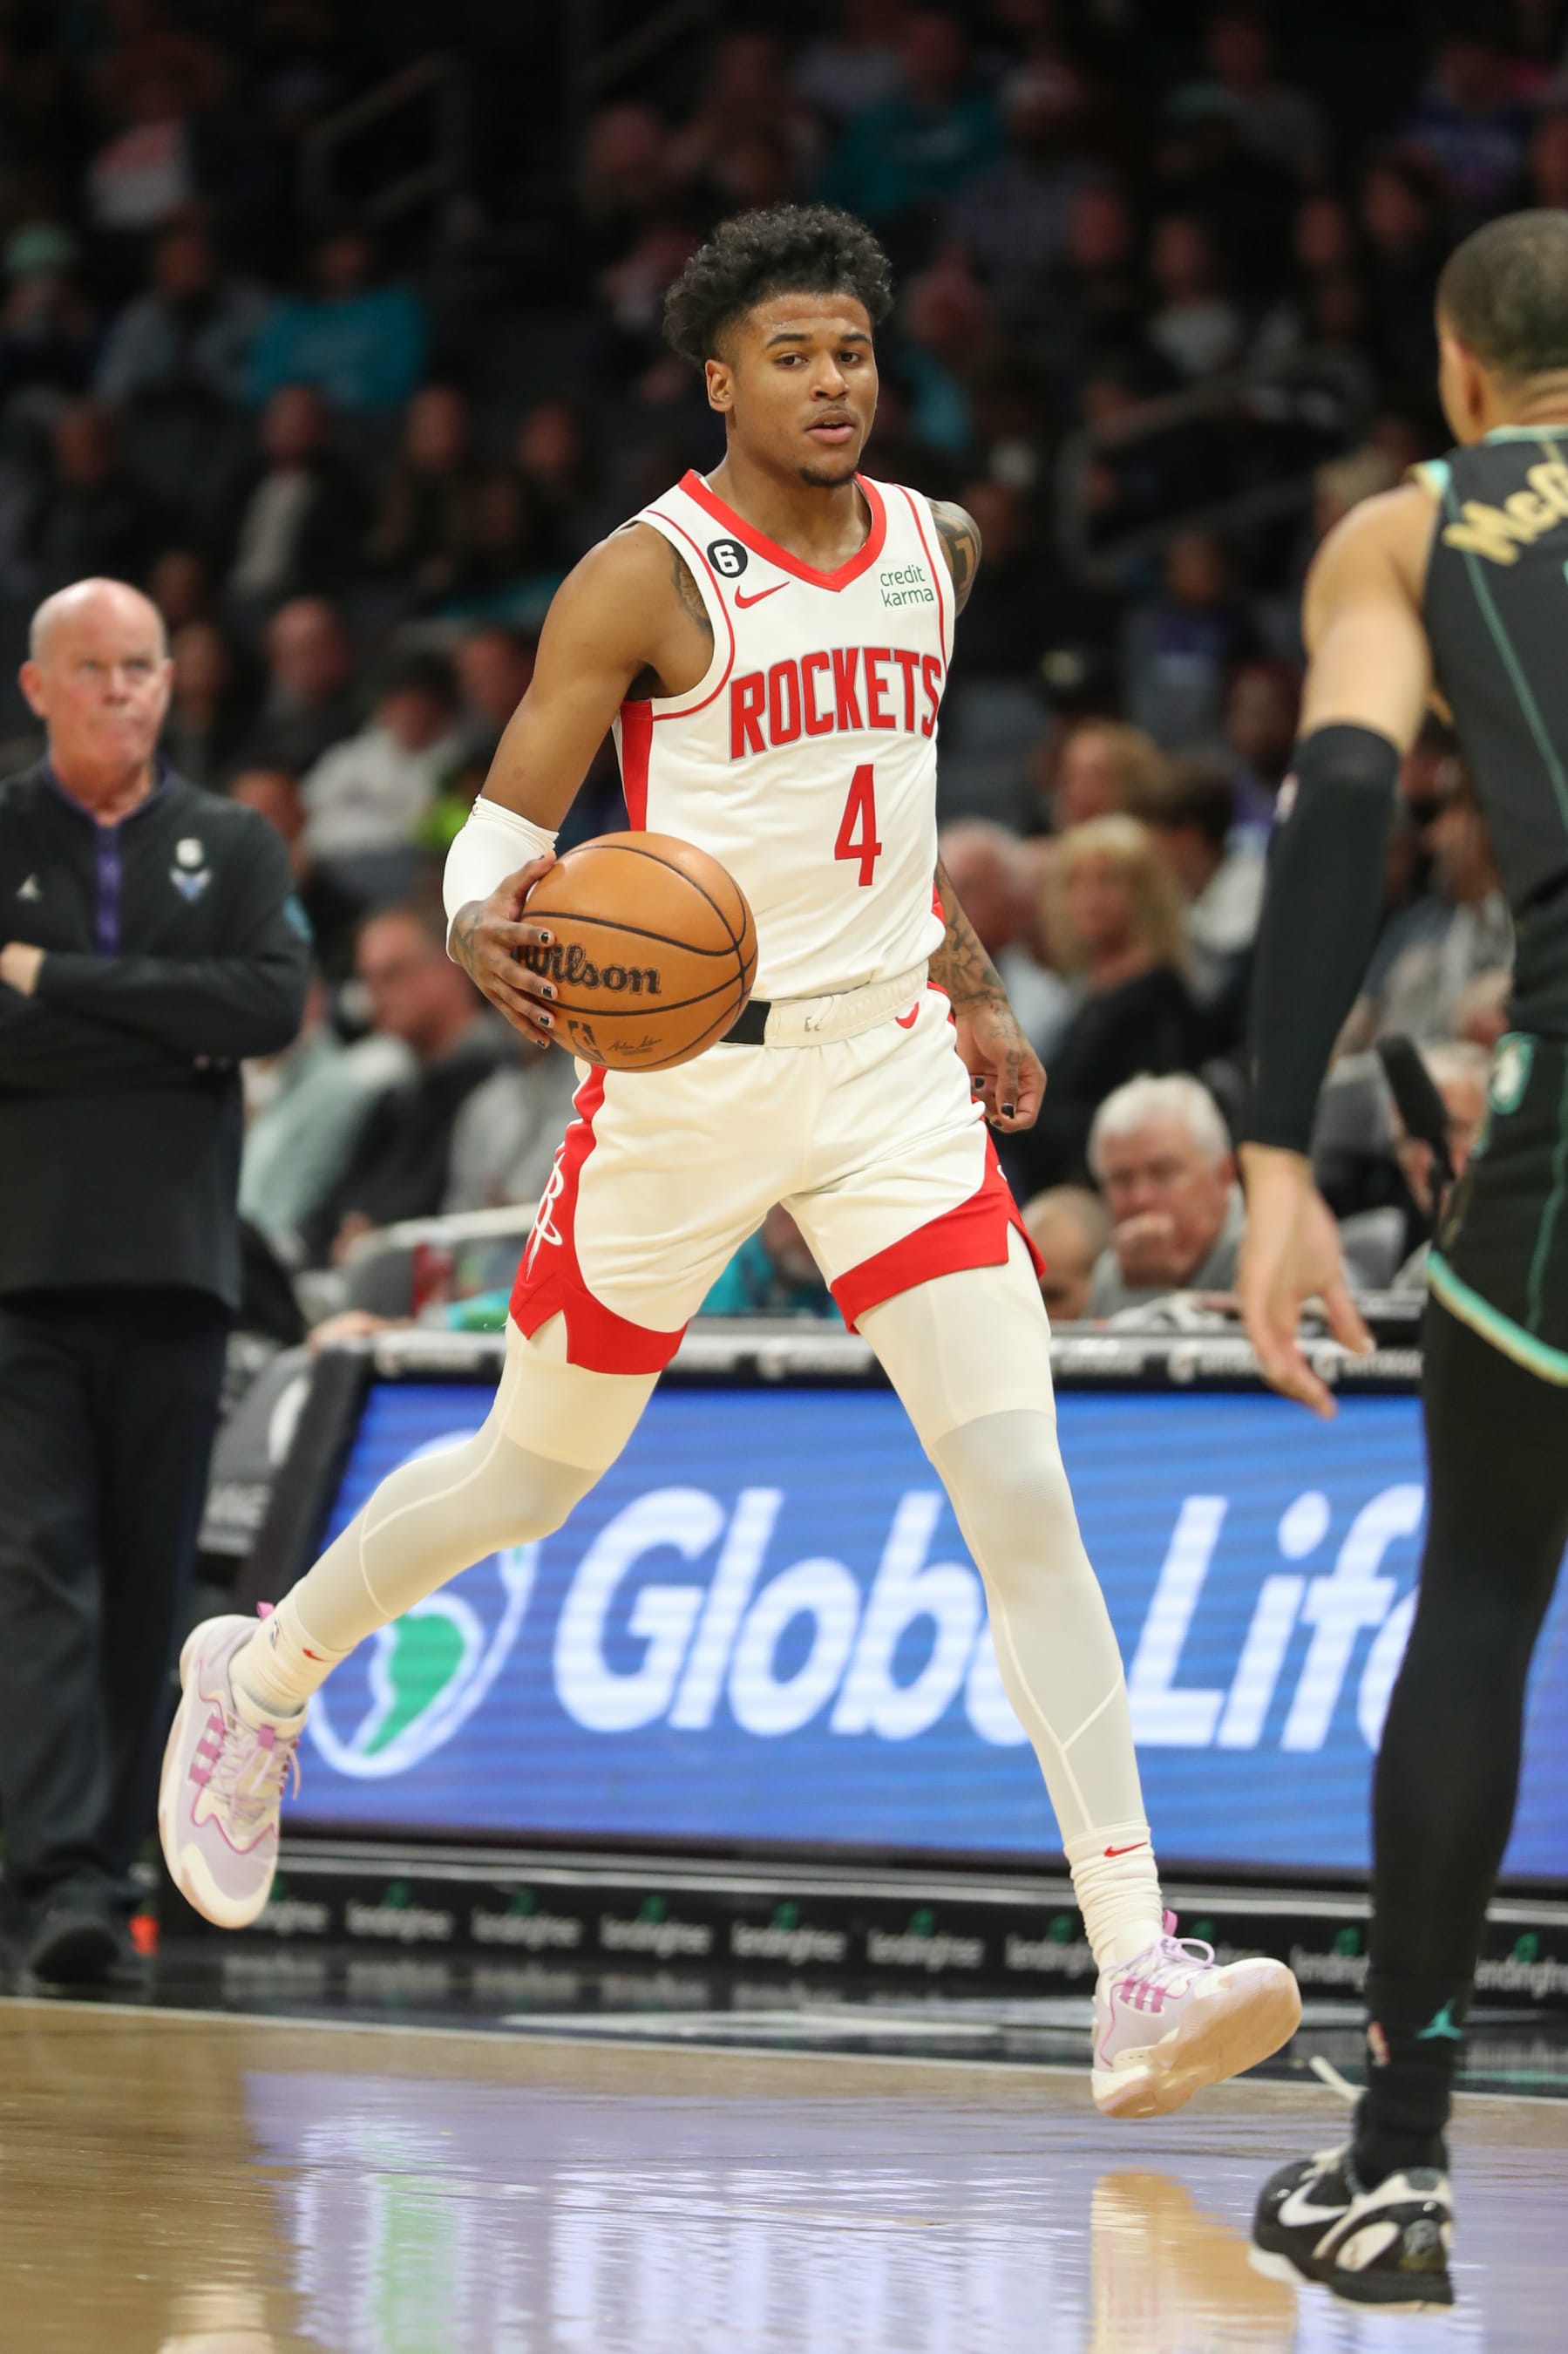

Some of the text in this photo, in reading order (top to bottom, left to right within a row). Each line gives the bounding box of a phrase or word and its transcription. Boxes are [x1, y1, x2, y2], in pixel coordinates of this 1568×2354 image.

[713, 543, 740, 575] 6
[879, 564, 926, 587] credit
[880, 588, 934, 608] karma
[729, 646, 942, 762] ROCKETS
[834, 764, 882, 887] 4
